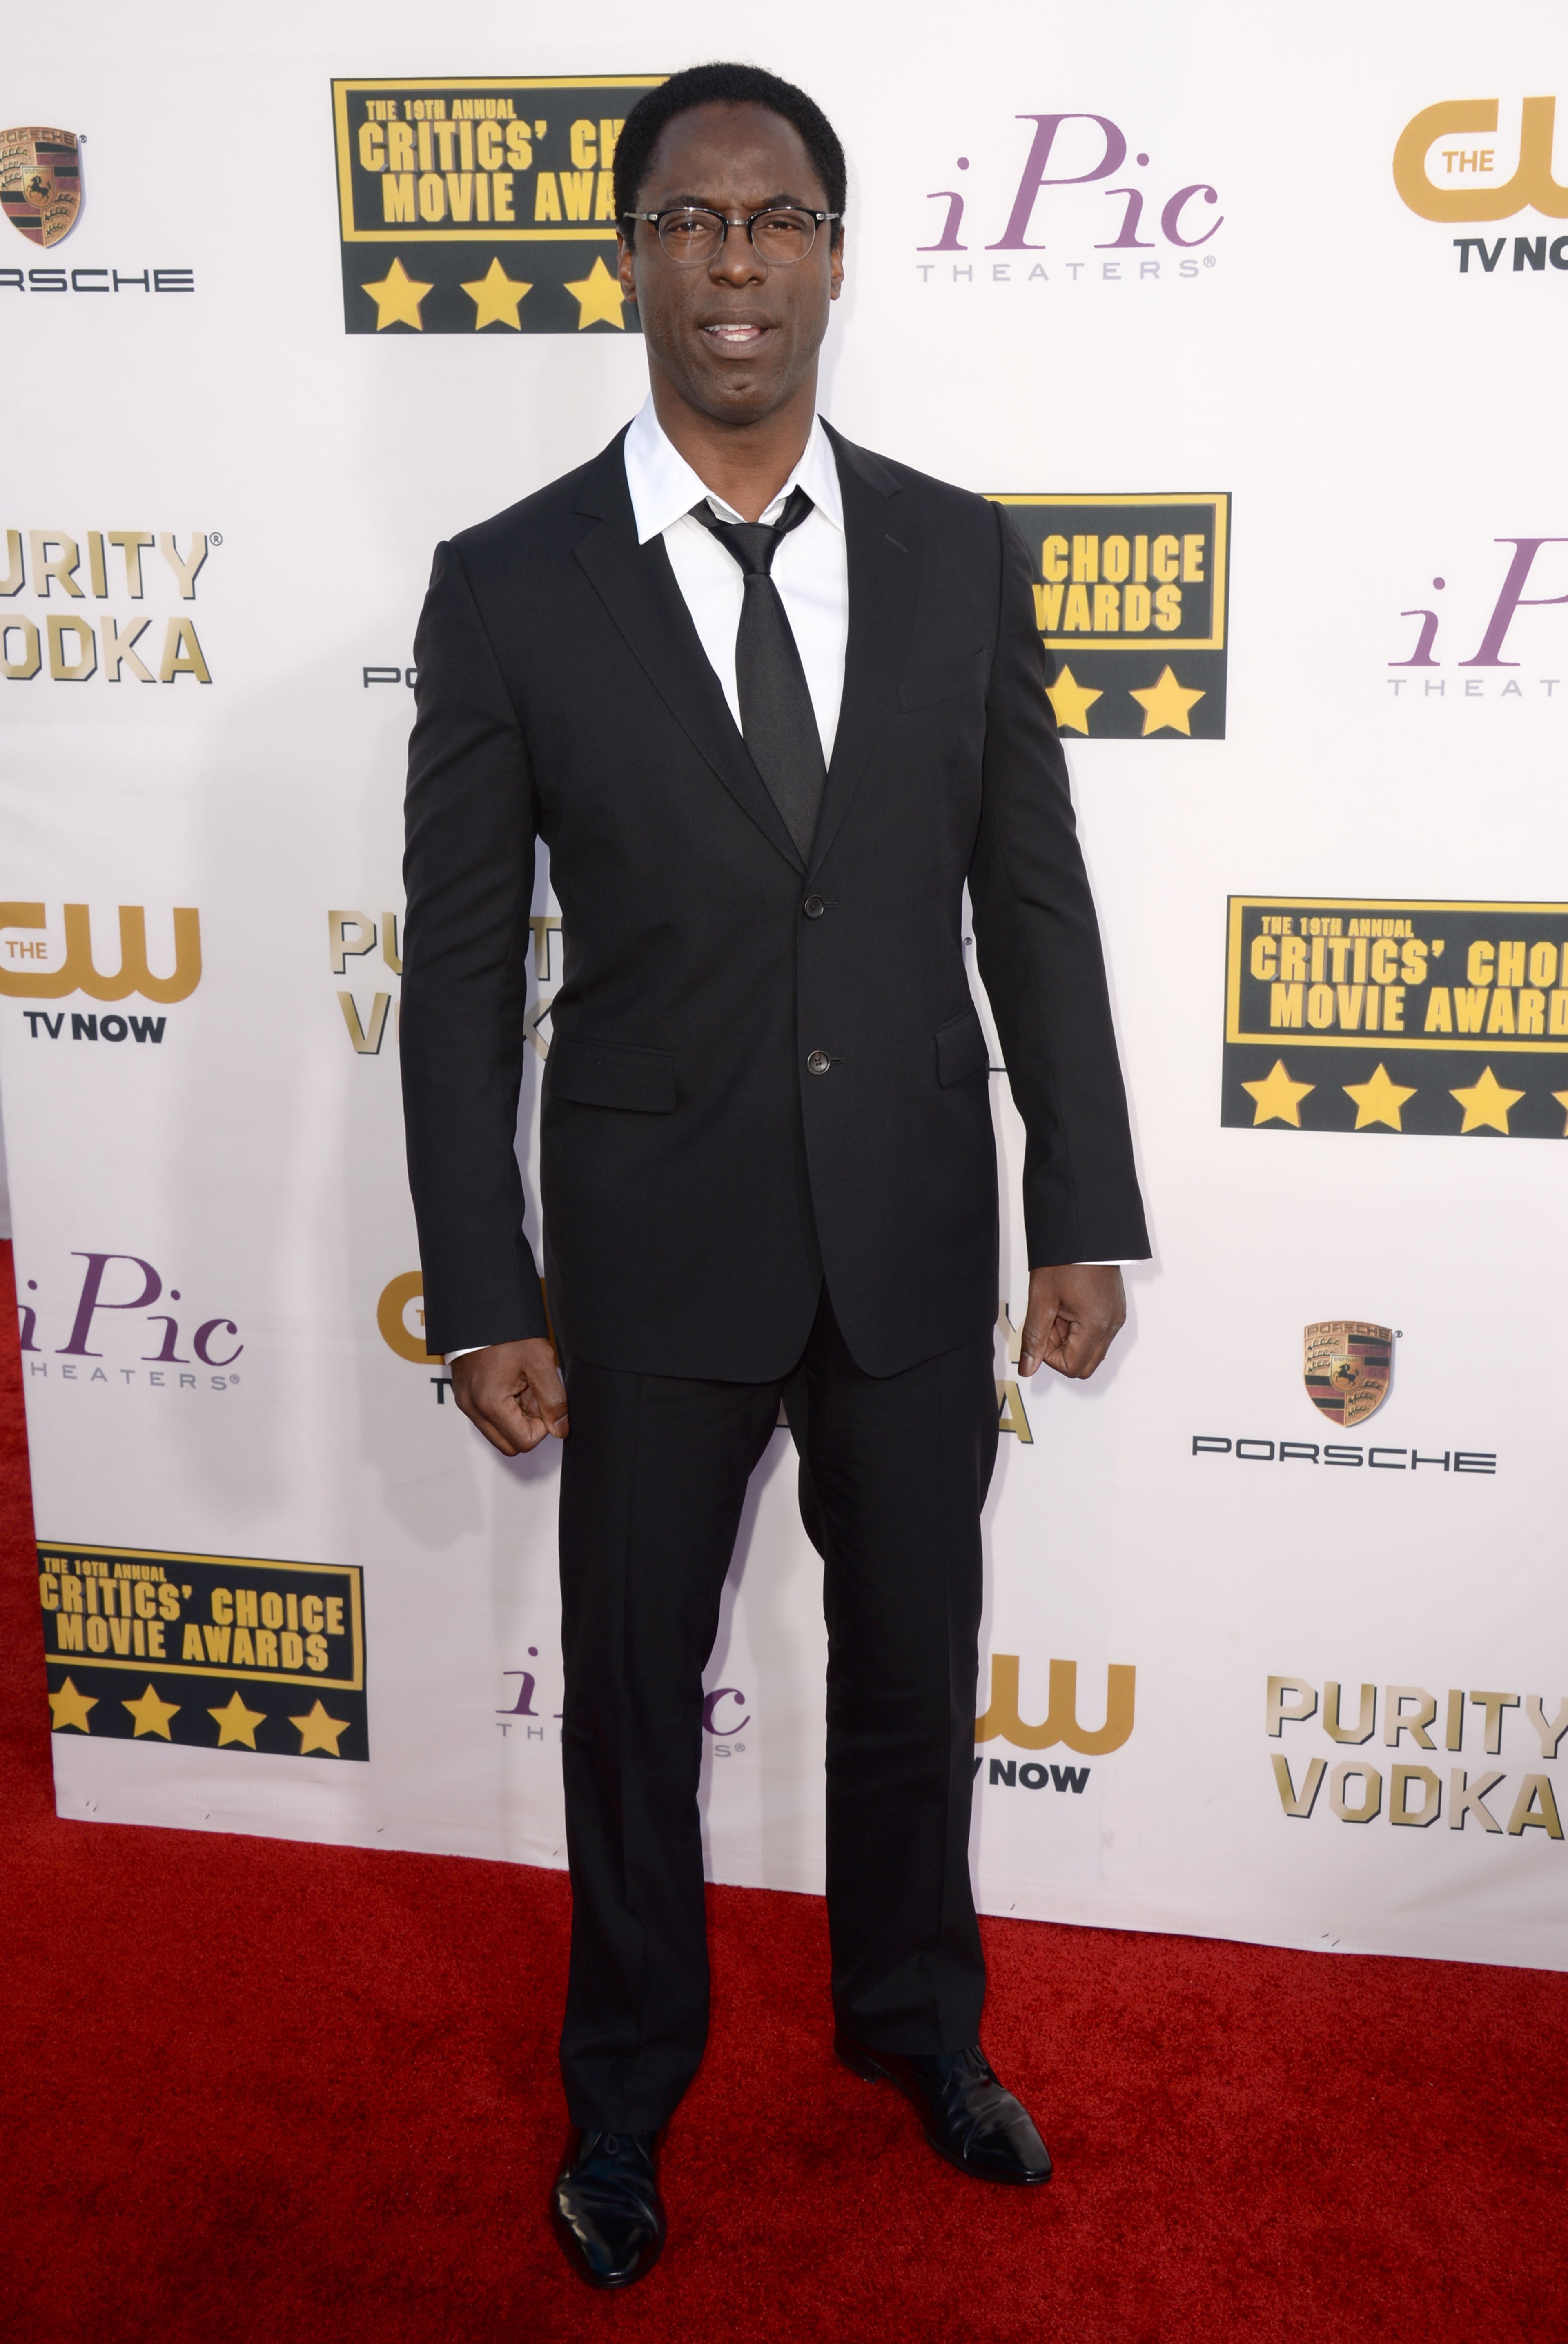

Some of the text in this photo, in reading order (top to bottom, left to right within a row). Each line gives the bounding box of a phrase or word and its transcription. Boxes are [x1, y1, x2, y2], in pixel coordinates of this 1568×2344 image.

[366, 99, 517, 120] THE 19TH ANNUAL
[359, 120, 547, 171] CRITICS'
[1442, 150, 1494, 173] THE
[382, 171, 617, 223] MOVIE AWA
[916, 114, 1224, 251] iPic
[1042, 534, 1205, 583] CHOICE
[1387, 679, 1561, 697] THEAT
[5, 941, 47, 959] THE
[1262, 916, 1414, 938] THE 19TH ANNUAL
[1250, 935, 1445, 985] CRITICS'
[71, 1013, 167, 1044] NOW
[1270, 982, 1407, 1031] MOVIE
[17, 1252, 243, 1366] iPic
[1307, 1323, 1390, 1340] PORSCHE
[1192, 1436, 1497, 1474] PORSCHE
[43, 1557, 167, 1583] THE 19TH ANNUAL
[39, 1573, 345, 1635] CRITICS' CHOICE
[56, 1613, 329, 1672] MOVIE AWARDS
[1266, 1676, 1568, 1759] PURITY
[989, 1758, 1091, 1794] NOW
[1270, 1753, 1566, 1841] VODKA
